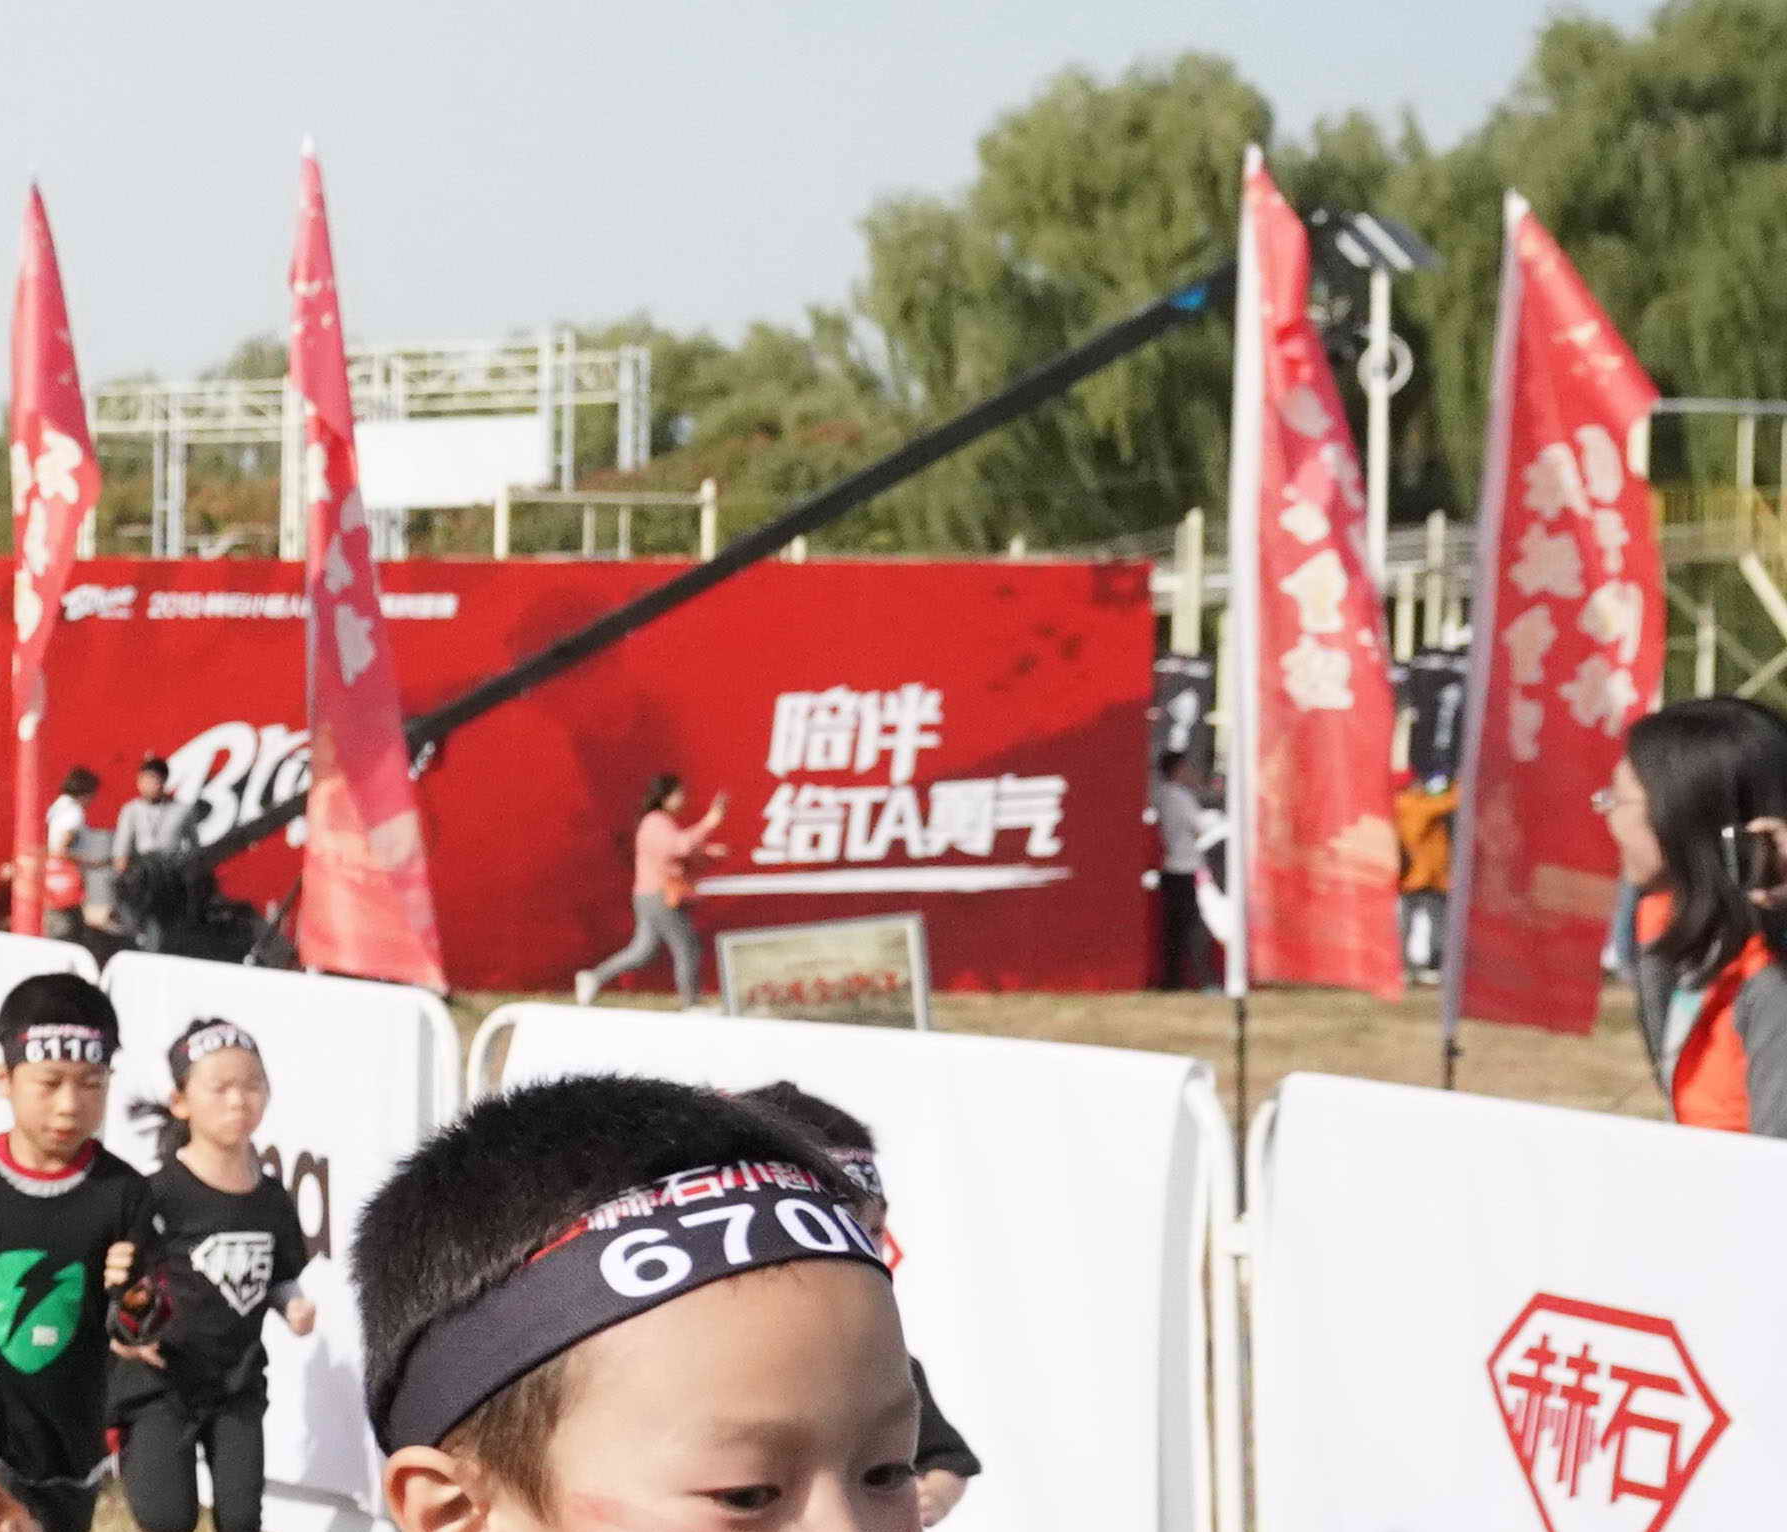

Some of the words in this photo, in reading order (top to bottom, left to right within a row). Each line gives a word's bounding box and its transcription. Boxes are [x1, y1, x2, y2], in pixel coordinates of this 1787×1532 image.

[766, 683, 944, 782] 陪伴
[752, 774, 1068, 865] 给TA勇气
[1507, 1334, 1688, 1504] 赫石
